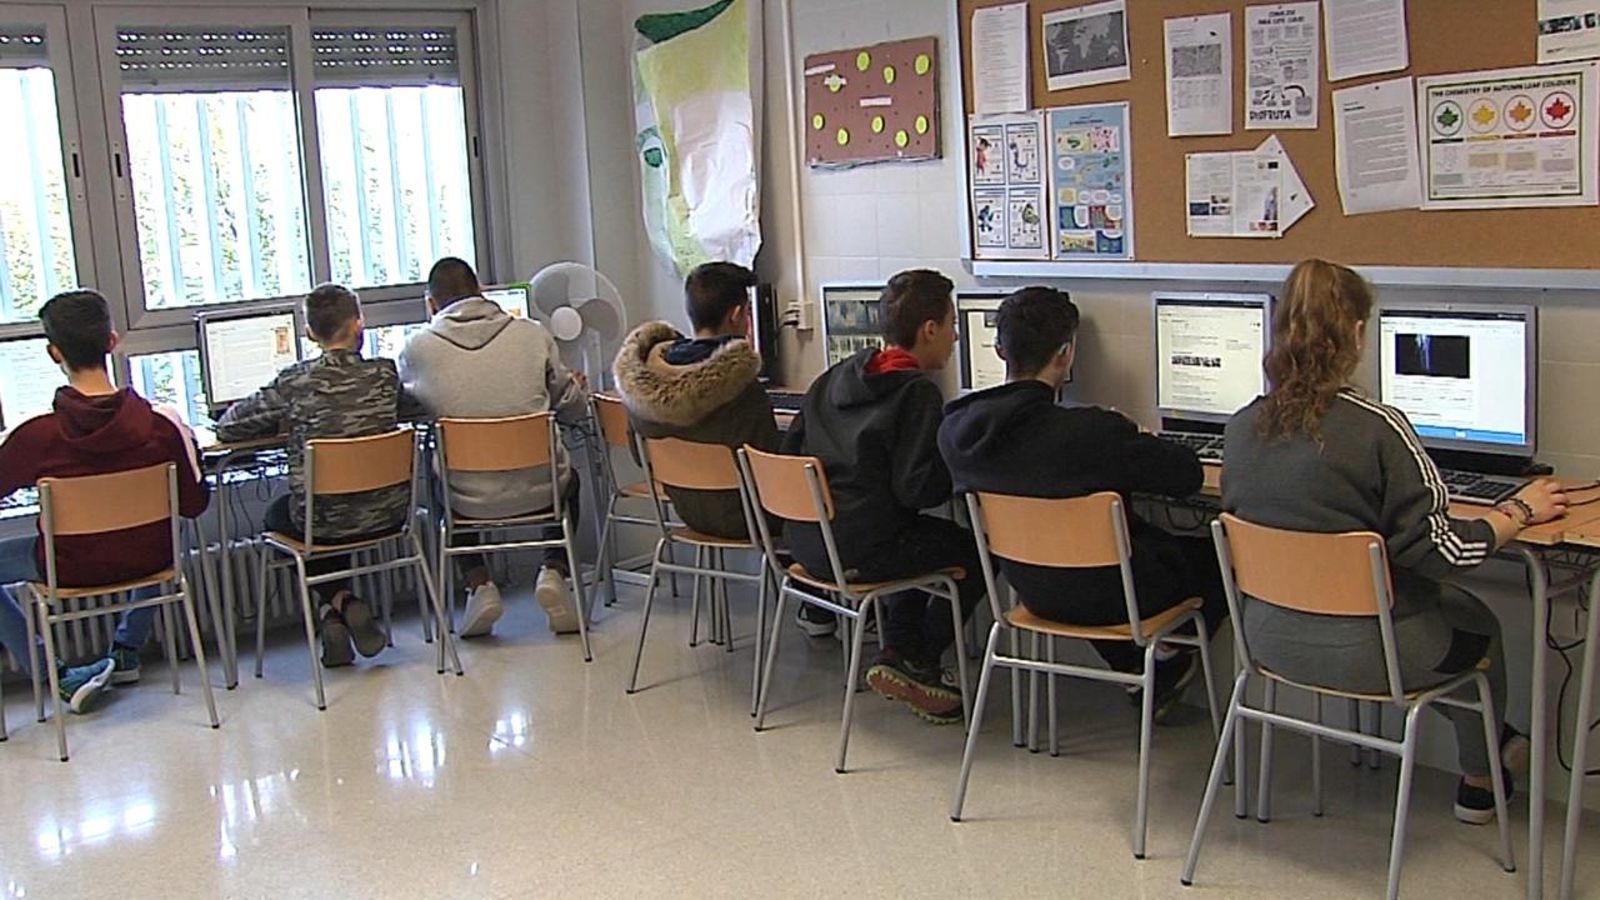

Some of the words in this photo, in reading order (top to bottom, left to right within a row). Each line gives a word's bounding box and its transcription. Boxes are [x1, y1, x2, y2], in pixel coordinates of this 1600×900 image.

[1445, 87, 1480, 96] CHEMISTRY
[1493, 84, 1523, 92] AUTUMN
[1524, 81, 1540, 89] LEAF
[1542, 79, 1577, 87] COLOURS
